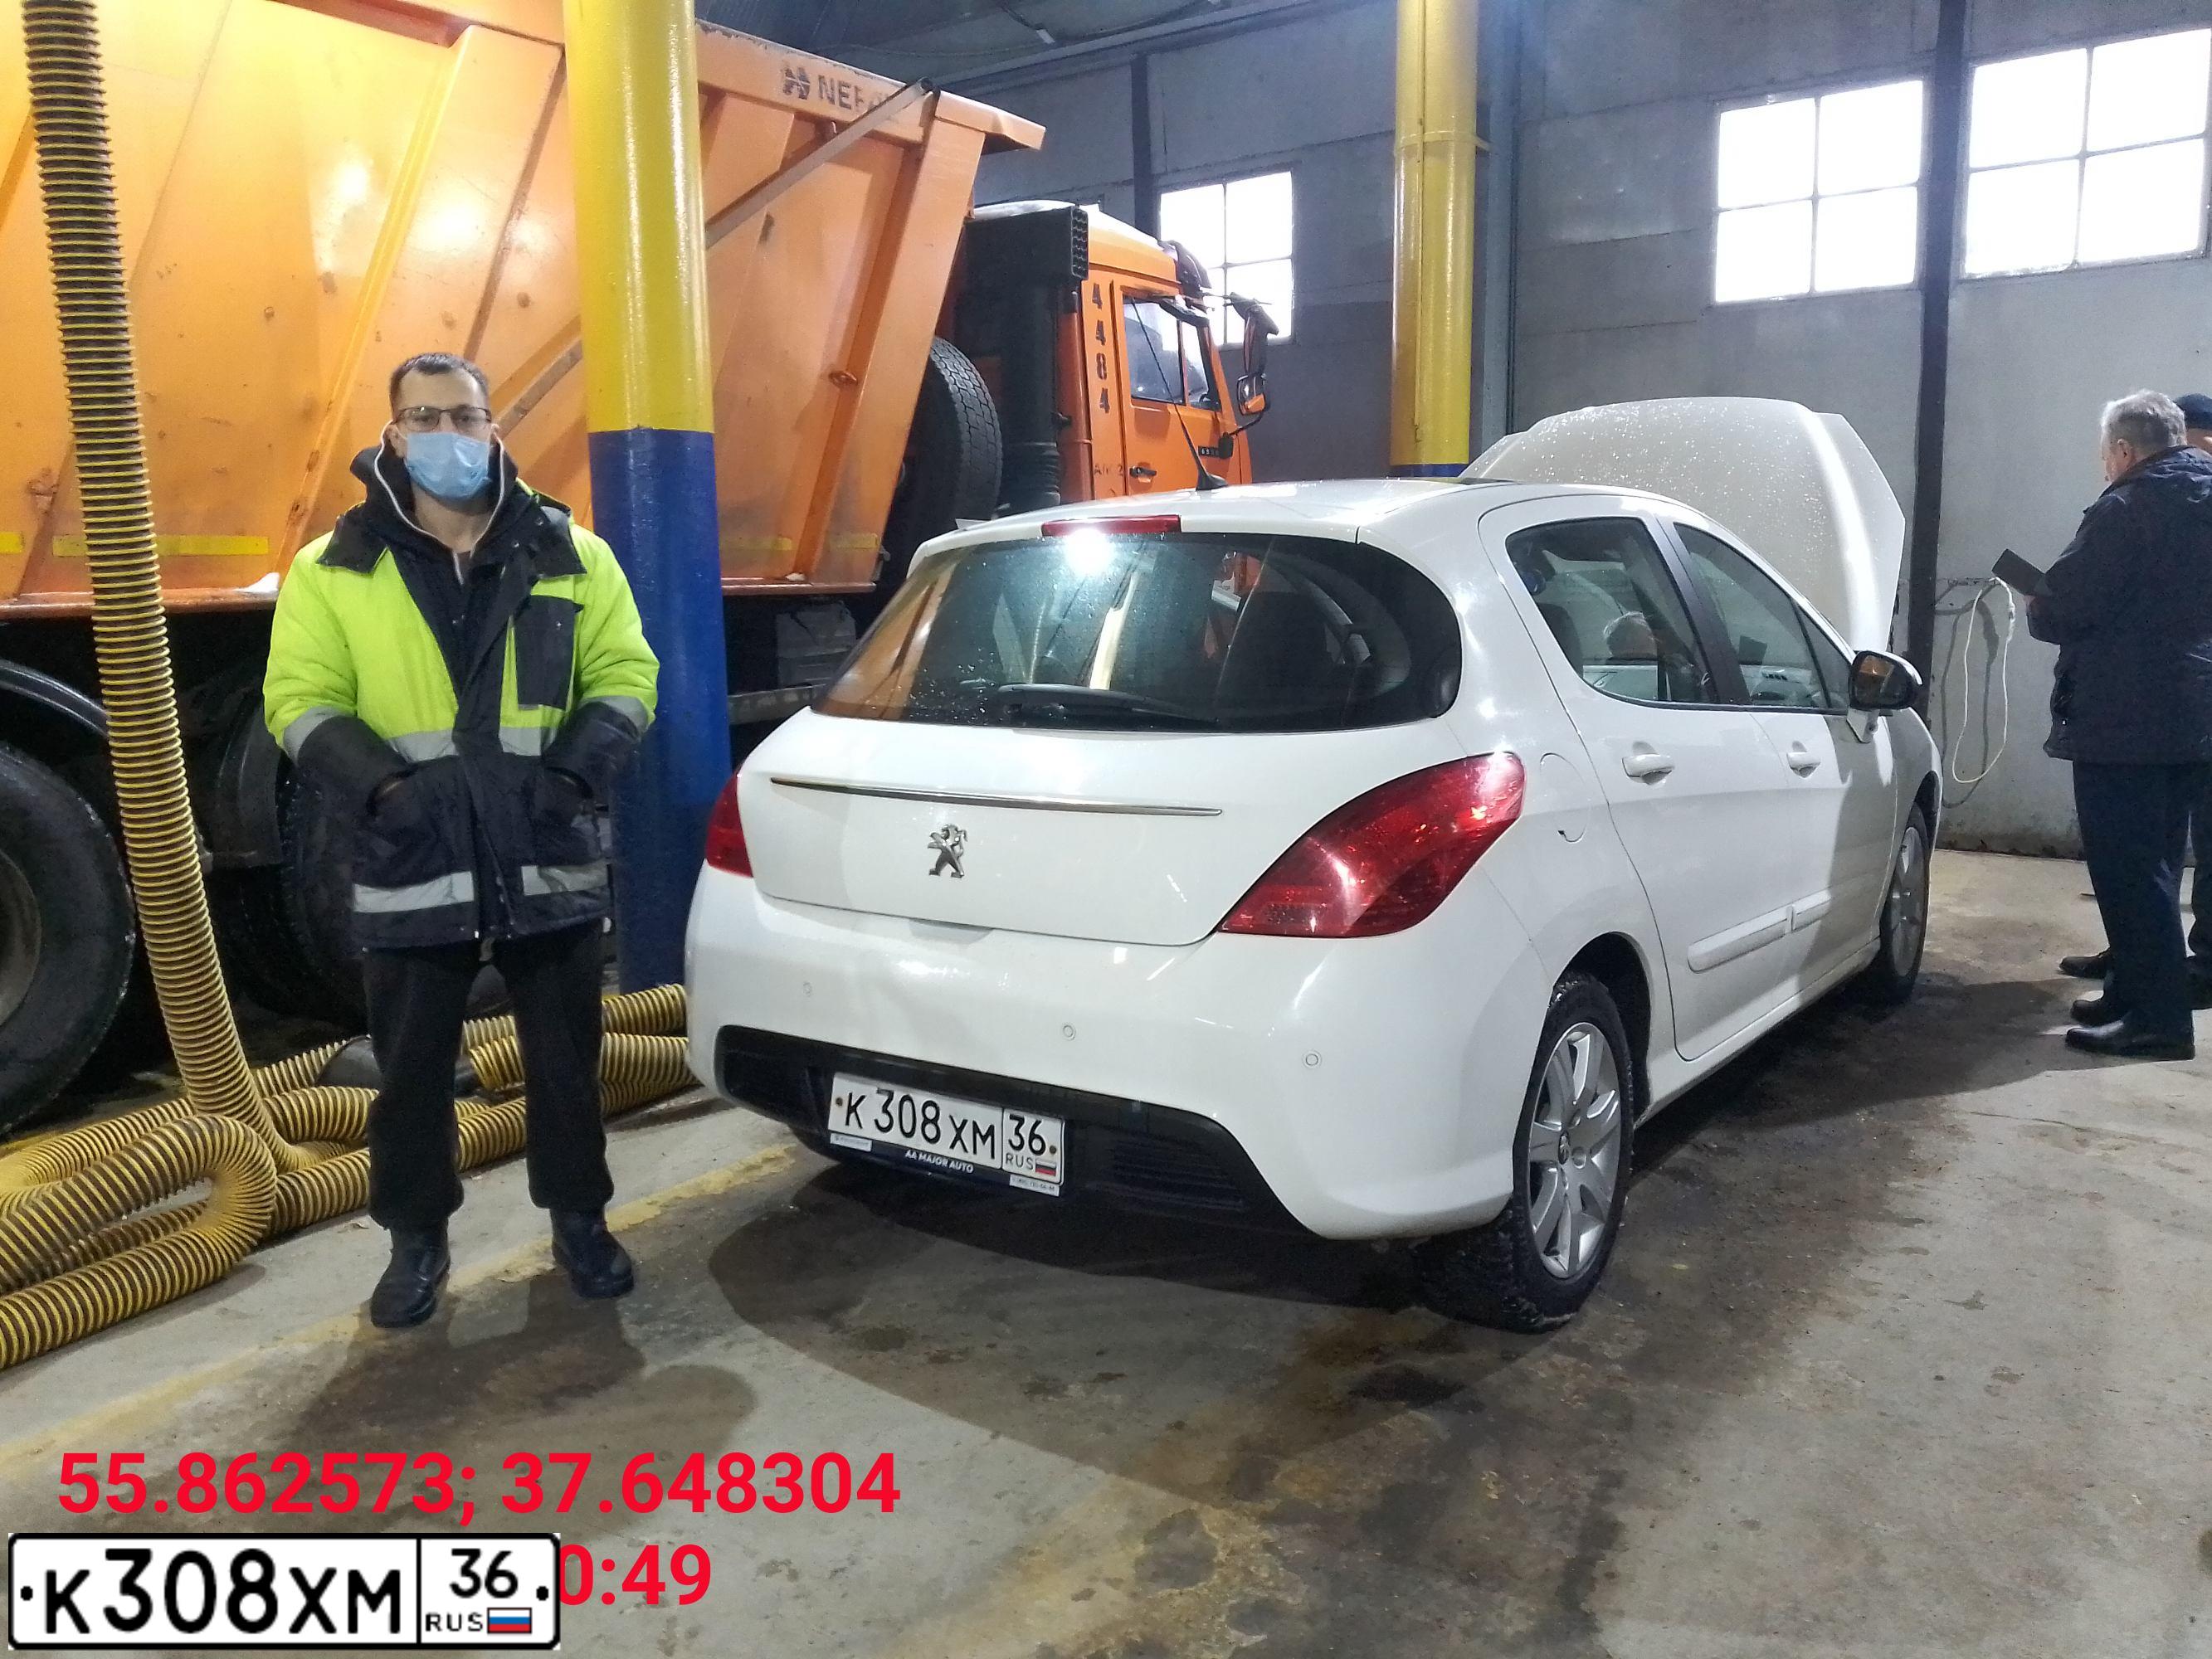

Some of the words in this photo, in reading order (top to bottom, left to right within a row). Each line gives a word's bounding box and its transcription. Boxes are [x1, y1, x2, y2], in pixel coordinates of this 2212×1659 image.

[1008, 1113, 1047, 1156] 36
[904, 1149, 918, 1160] AA
[918, 1152, 948, 1167] MAJOR
[948, 1160, 975, 1174] AUTO
[1005, 1152, 1034, 1171] RUS
